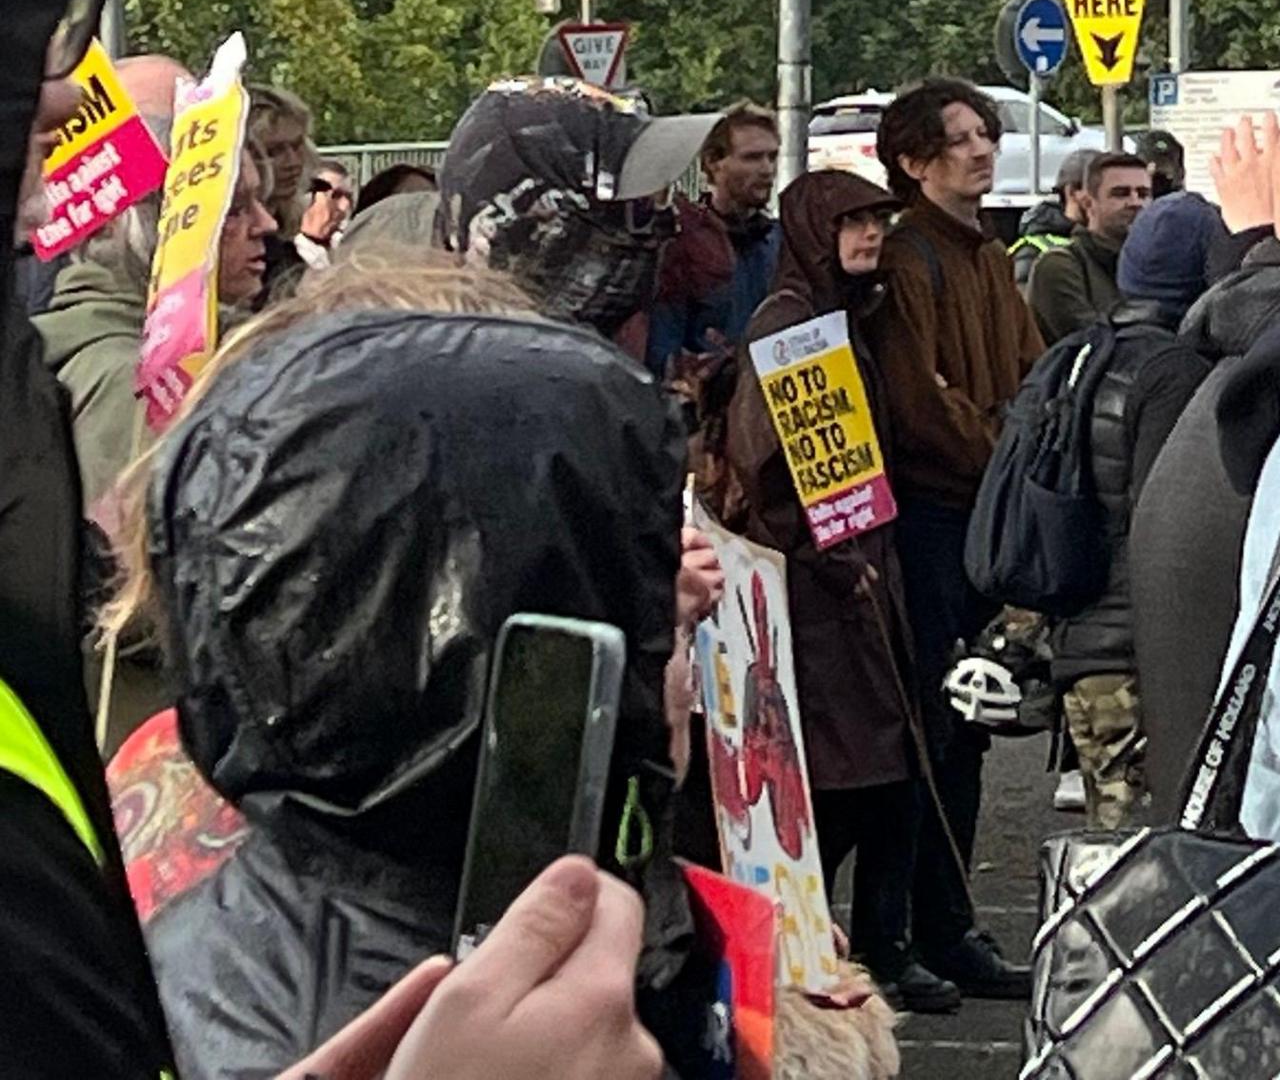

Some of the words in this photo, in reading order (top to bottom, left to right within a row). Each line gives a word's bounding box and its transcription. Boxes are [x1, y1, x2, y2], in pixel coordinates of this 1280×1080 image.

[573, 36, 615, 54] GIVE
[1157, 80, 1175, 105] P
[768, 376, 799, 407] NO
[799, 365, 827, 399] TO
[788, 438, 816, 468] NO
[817, 422, 847, 457] TO
[797, 442, 876, 496] FASCISM
[1180, 764, 1218, 831] HOUSE
[1205, 737, 1225, 768] OF
[1215, 663, 1256, 741] HOLLAND
